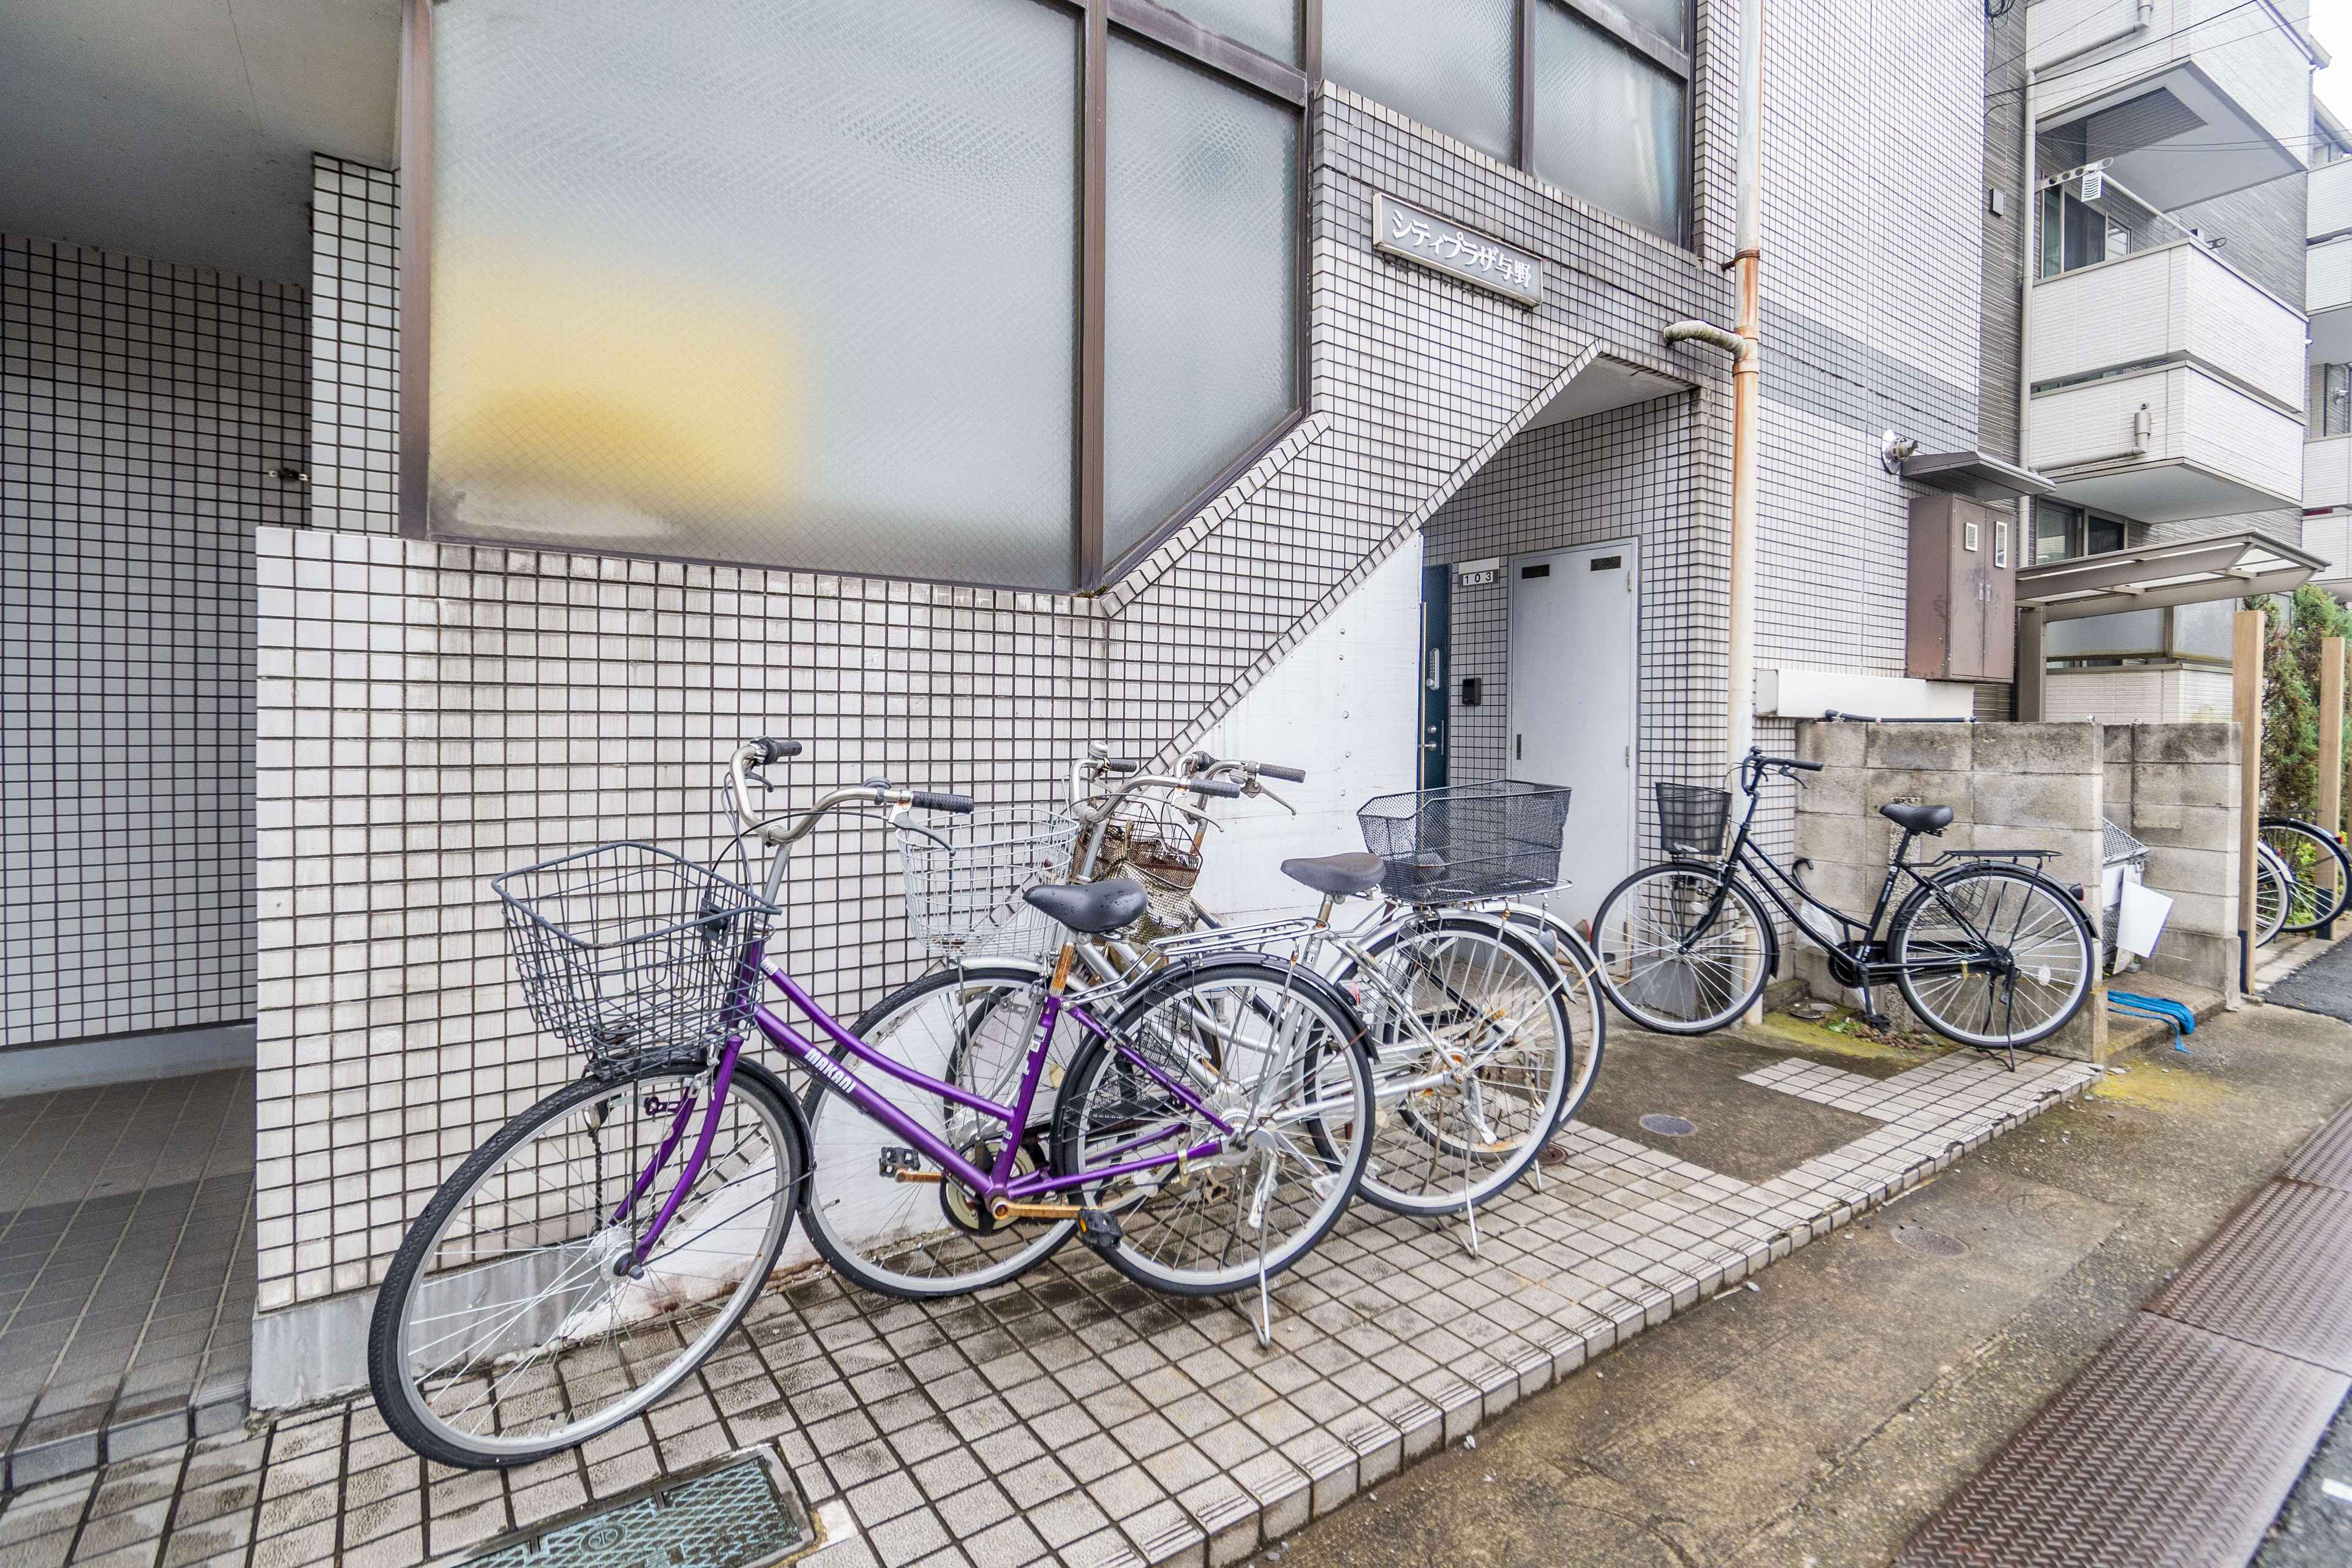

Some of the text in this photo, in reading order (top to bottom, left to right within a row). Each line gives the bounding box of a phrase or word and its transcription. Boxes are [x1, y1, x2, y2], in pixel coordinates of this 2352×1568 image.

[1392, 209, 1531, 288] シティプラザ与野
[1464, 572, 1491, 584] 103
[804, 1047, 857, 1094] MAKANI
